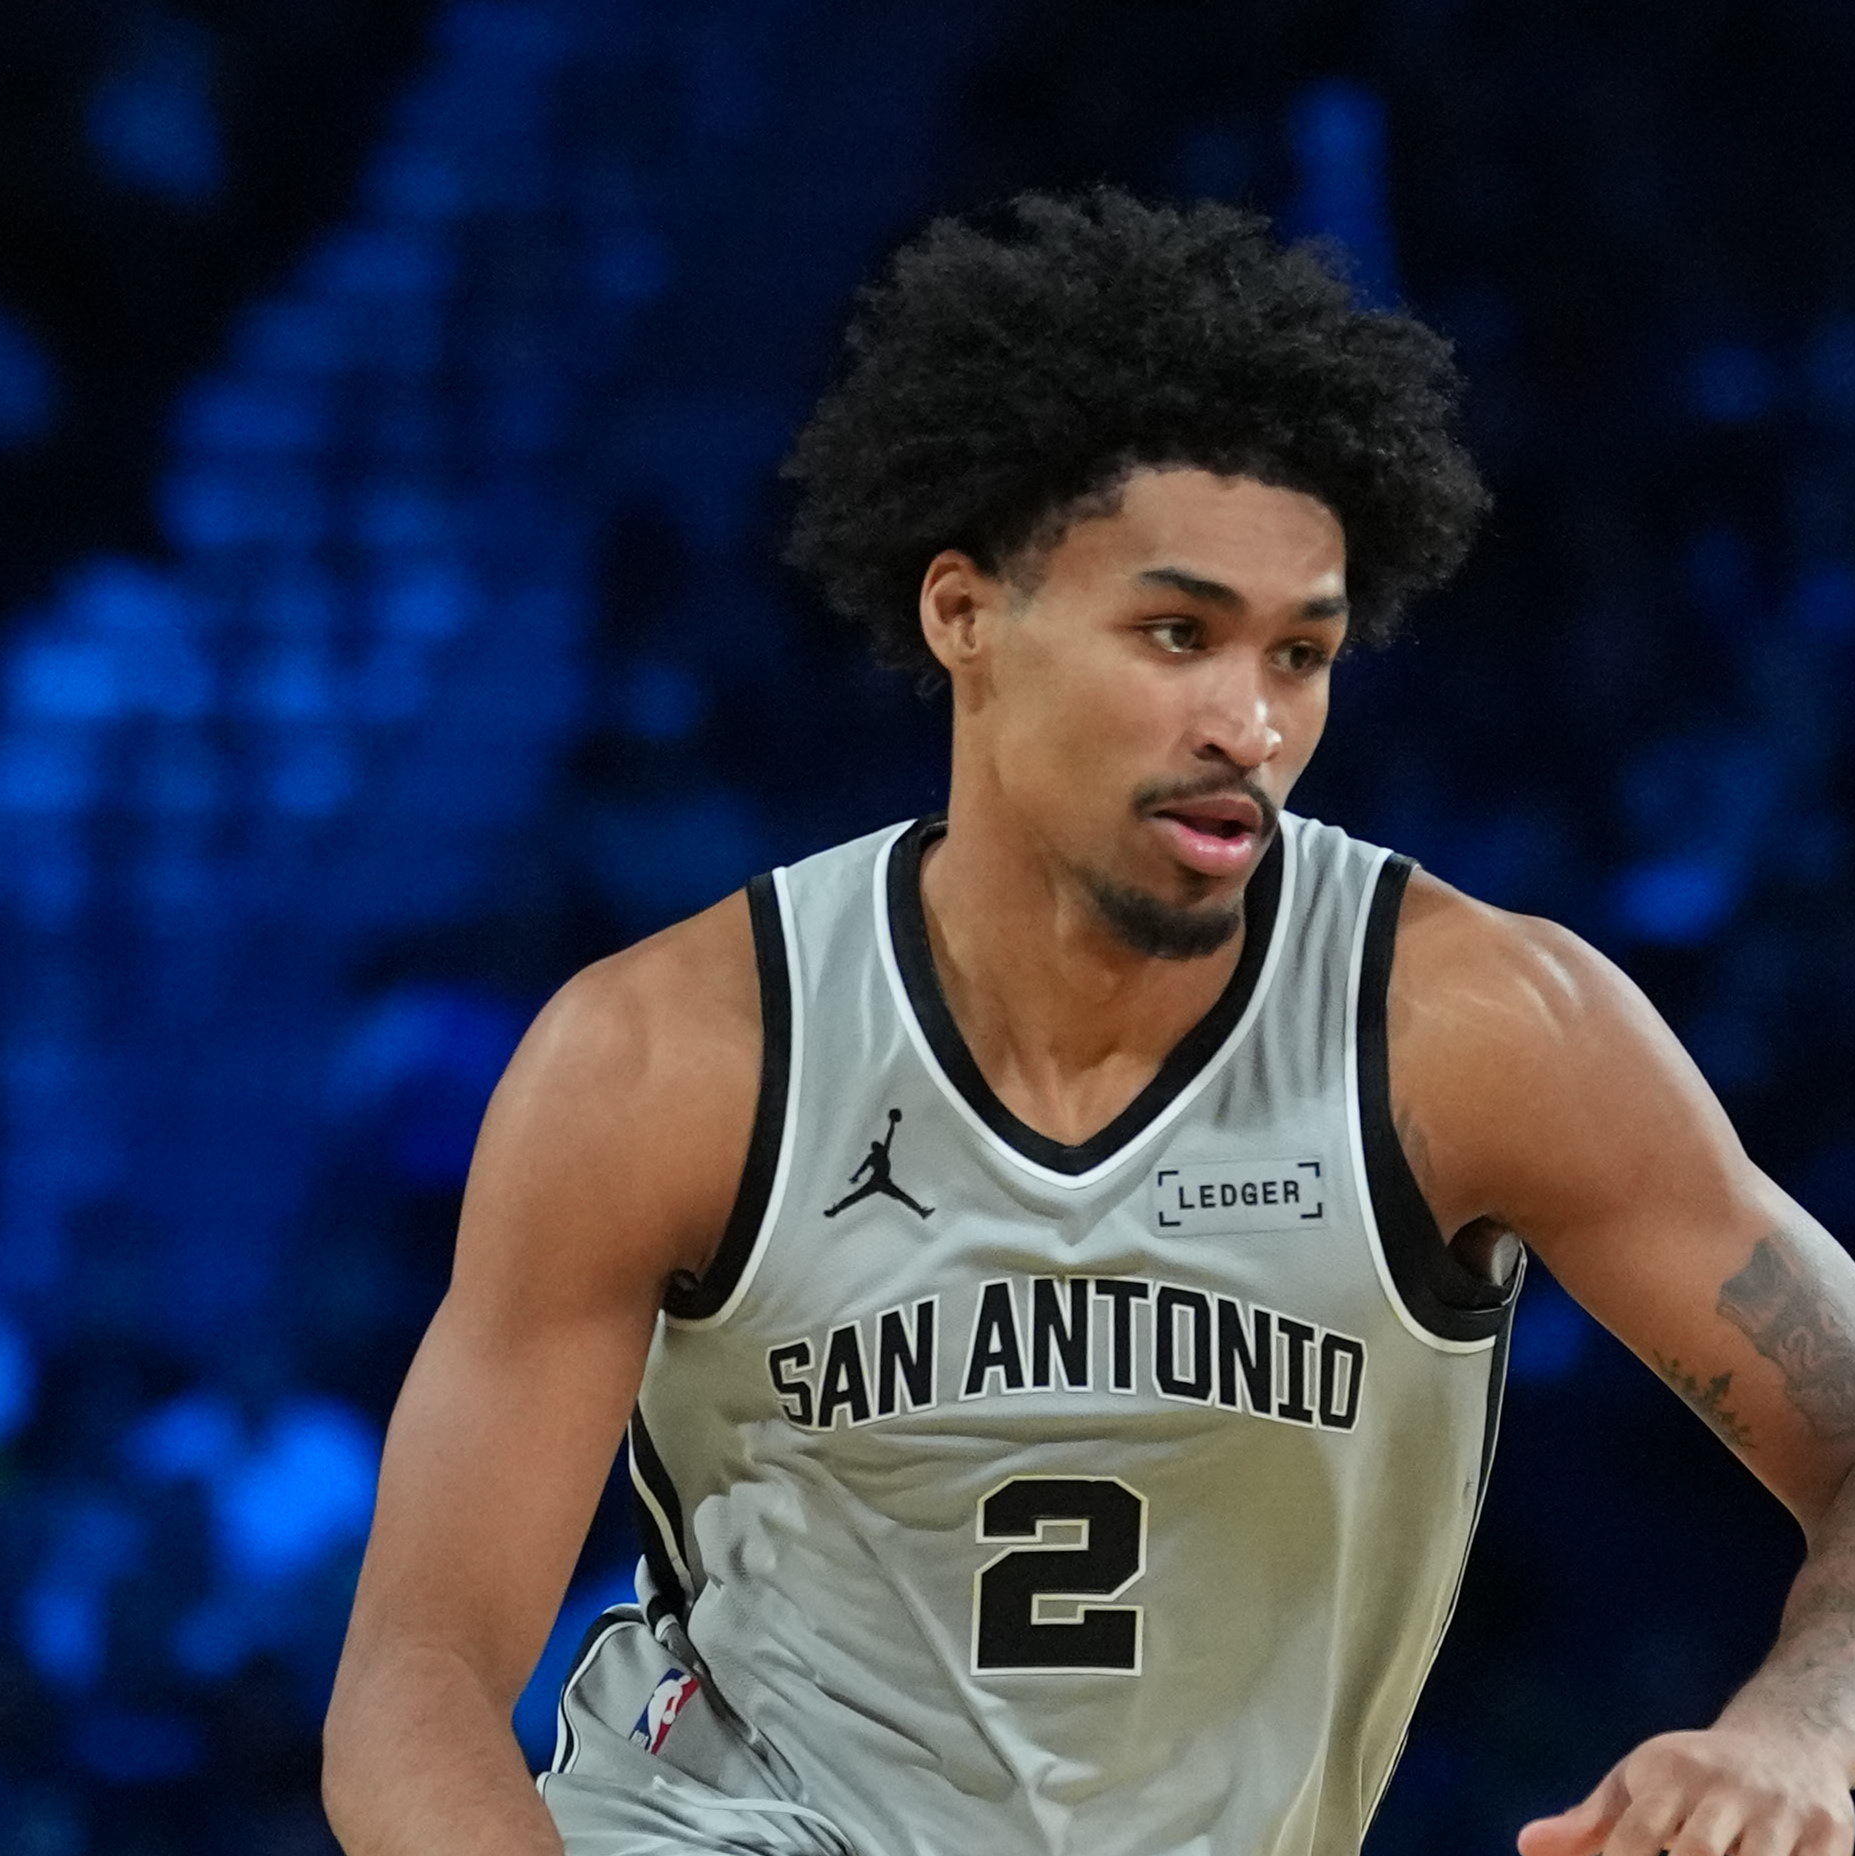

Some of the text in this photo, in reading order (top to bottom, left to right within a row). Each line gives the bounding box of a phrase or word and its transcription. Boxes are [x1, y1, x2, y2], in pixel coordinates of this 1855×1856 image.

[1179, 1180, 1300, 1210] LEDGER
[768, 1275, 1367, 1433] SAN ANTONIO
[971, 1476, 1149, 1676] 2
